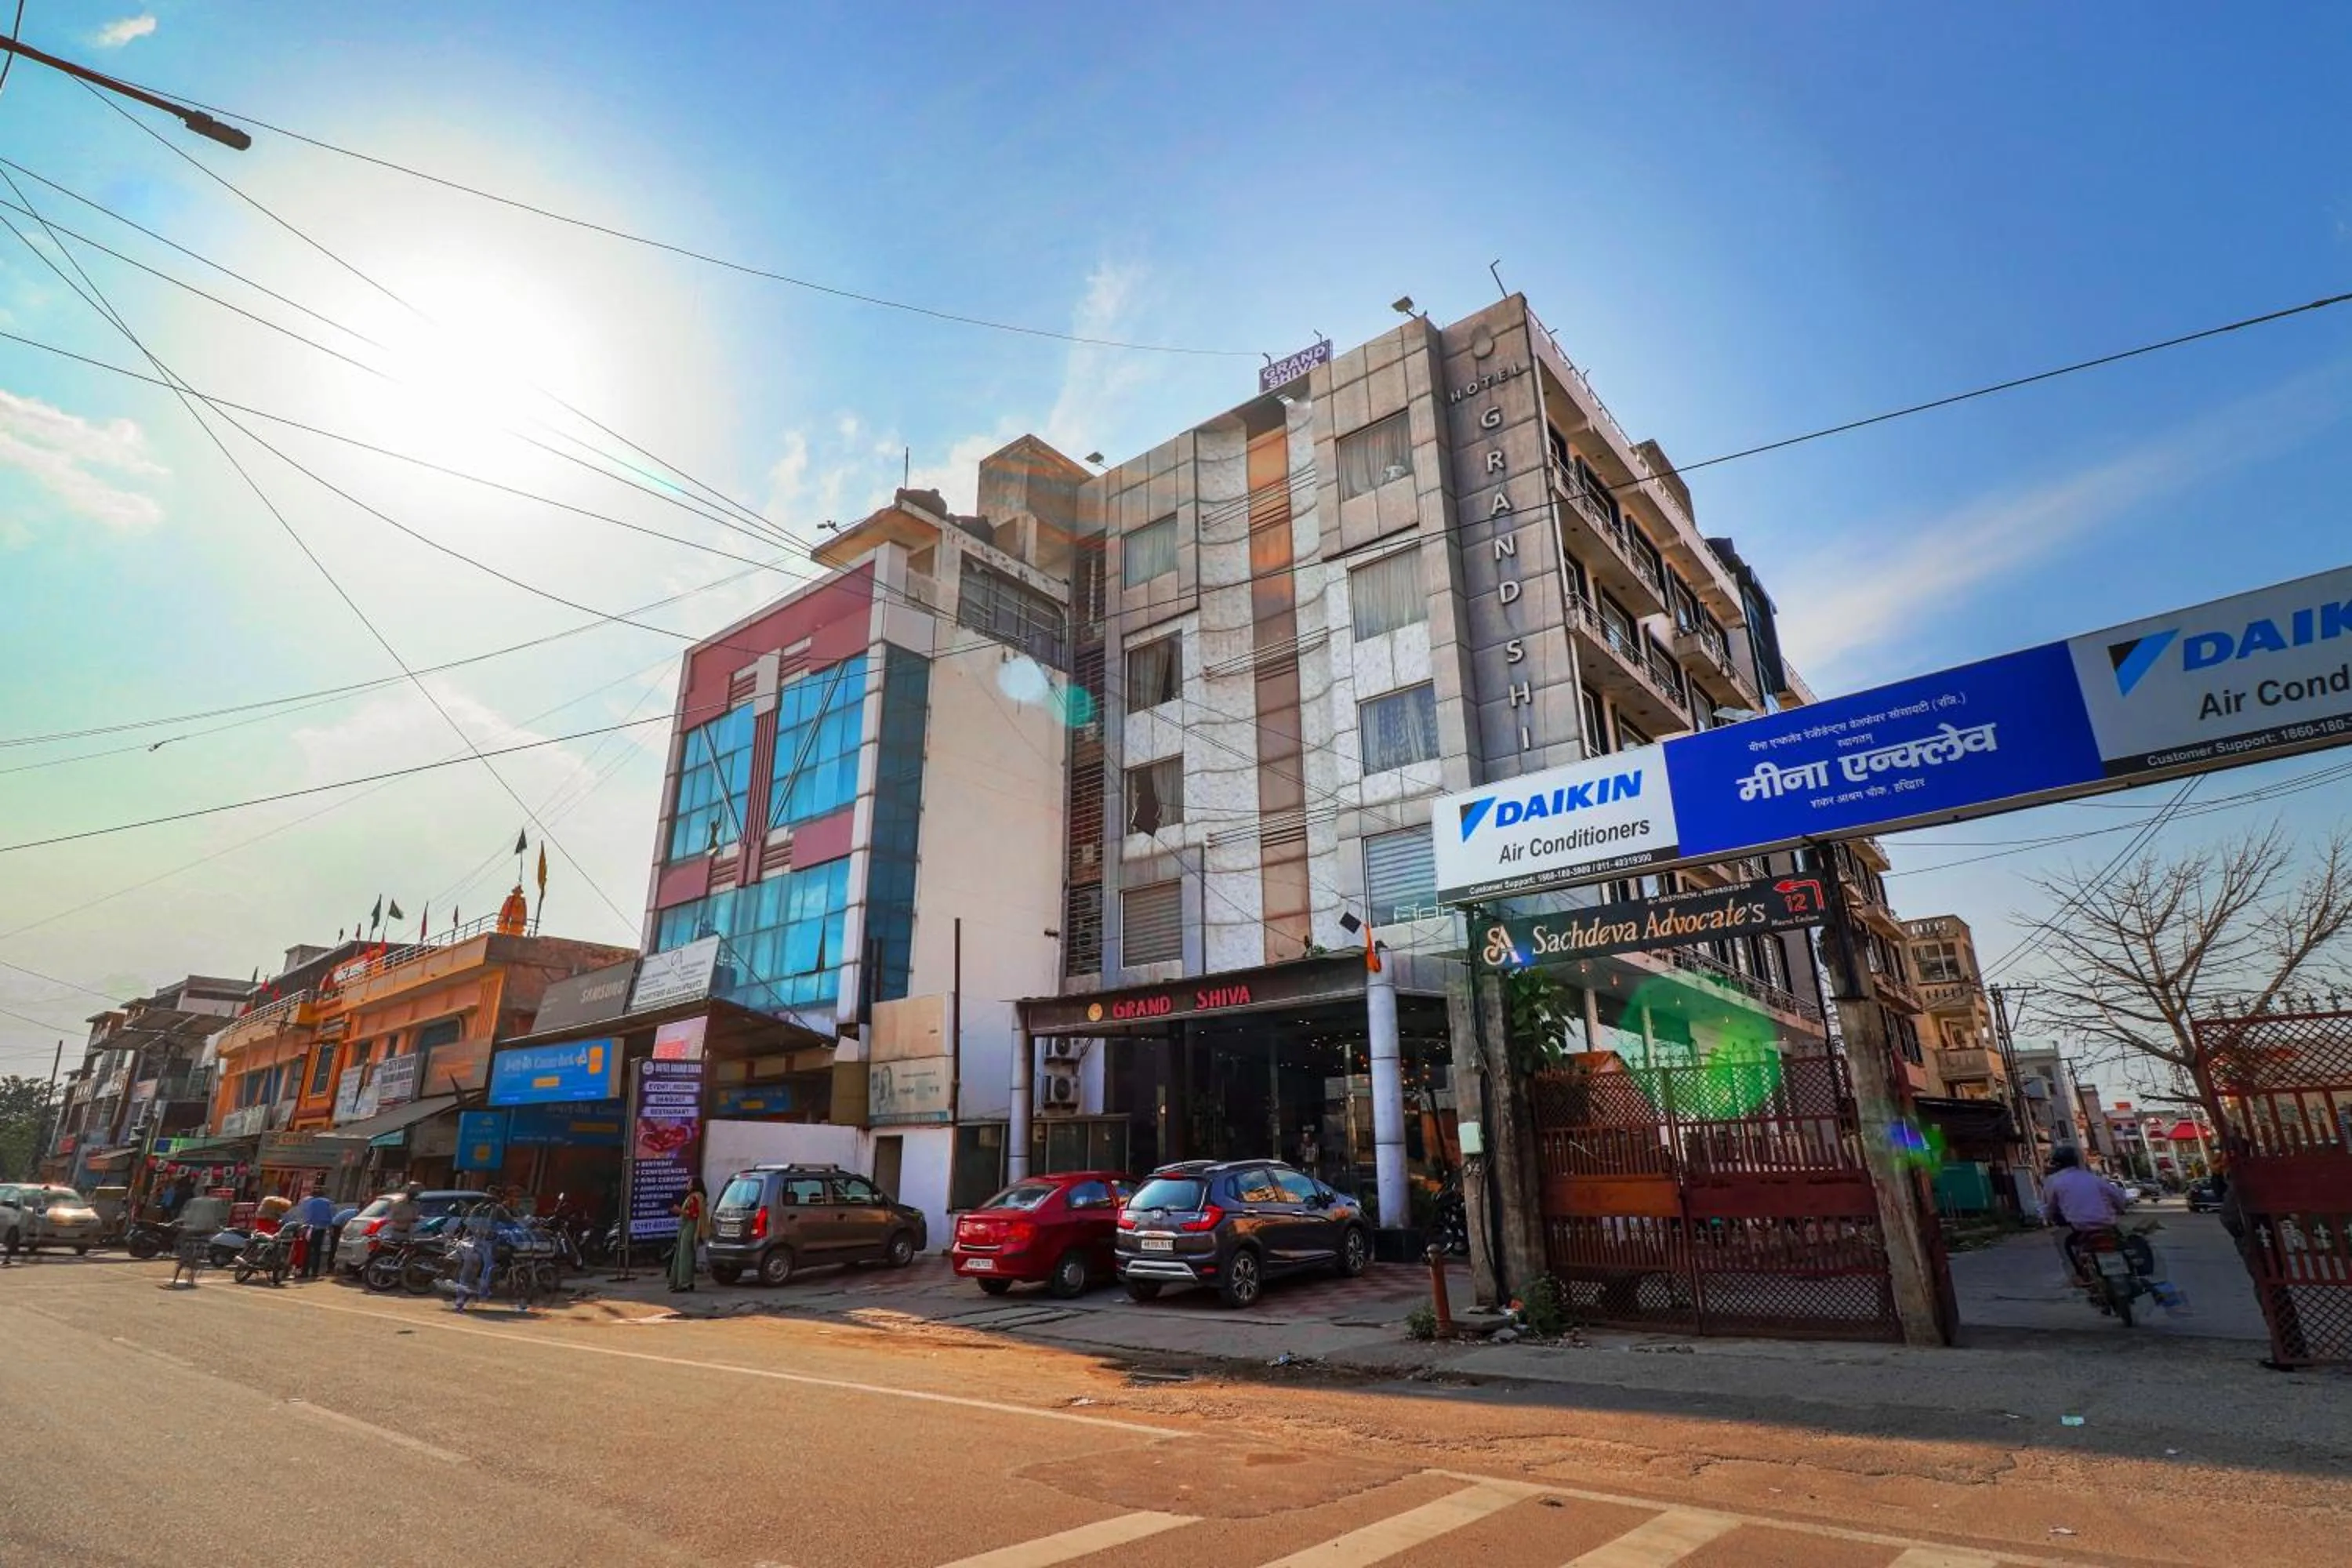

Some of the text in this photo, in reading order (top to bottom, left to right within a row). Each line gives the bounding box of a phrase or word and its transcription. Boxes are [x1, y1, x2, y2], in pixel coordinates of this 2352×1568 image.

[1263, 345, 1326, 379] GRAND
[1450, 361, 1519, 403] HOTEL
[1480, 405, 1522, 605] GRAND
[2198, 663, 2350, 720] Air Cond
[1735, 722, 1998, 801] मीना एन्क्लेव
[2147, 716, 2352, 767] Customer Support: 1860-180-
[1496, 769, 1642, 828] DAIKIN
[1499, 819, 1650, 864] Air Conditioners
[1468, 882, 1503, 895] Customer
[1532, 916, 1639, 955] Sachdeva
[1642, 898, 1766, 939] Advocate's
[1784, 894, 1808, 913] 12
[1112, 985, 1250, 1018] GRAND SHIVA
